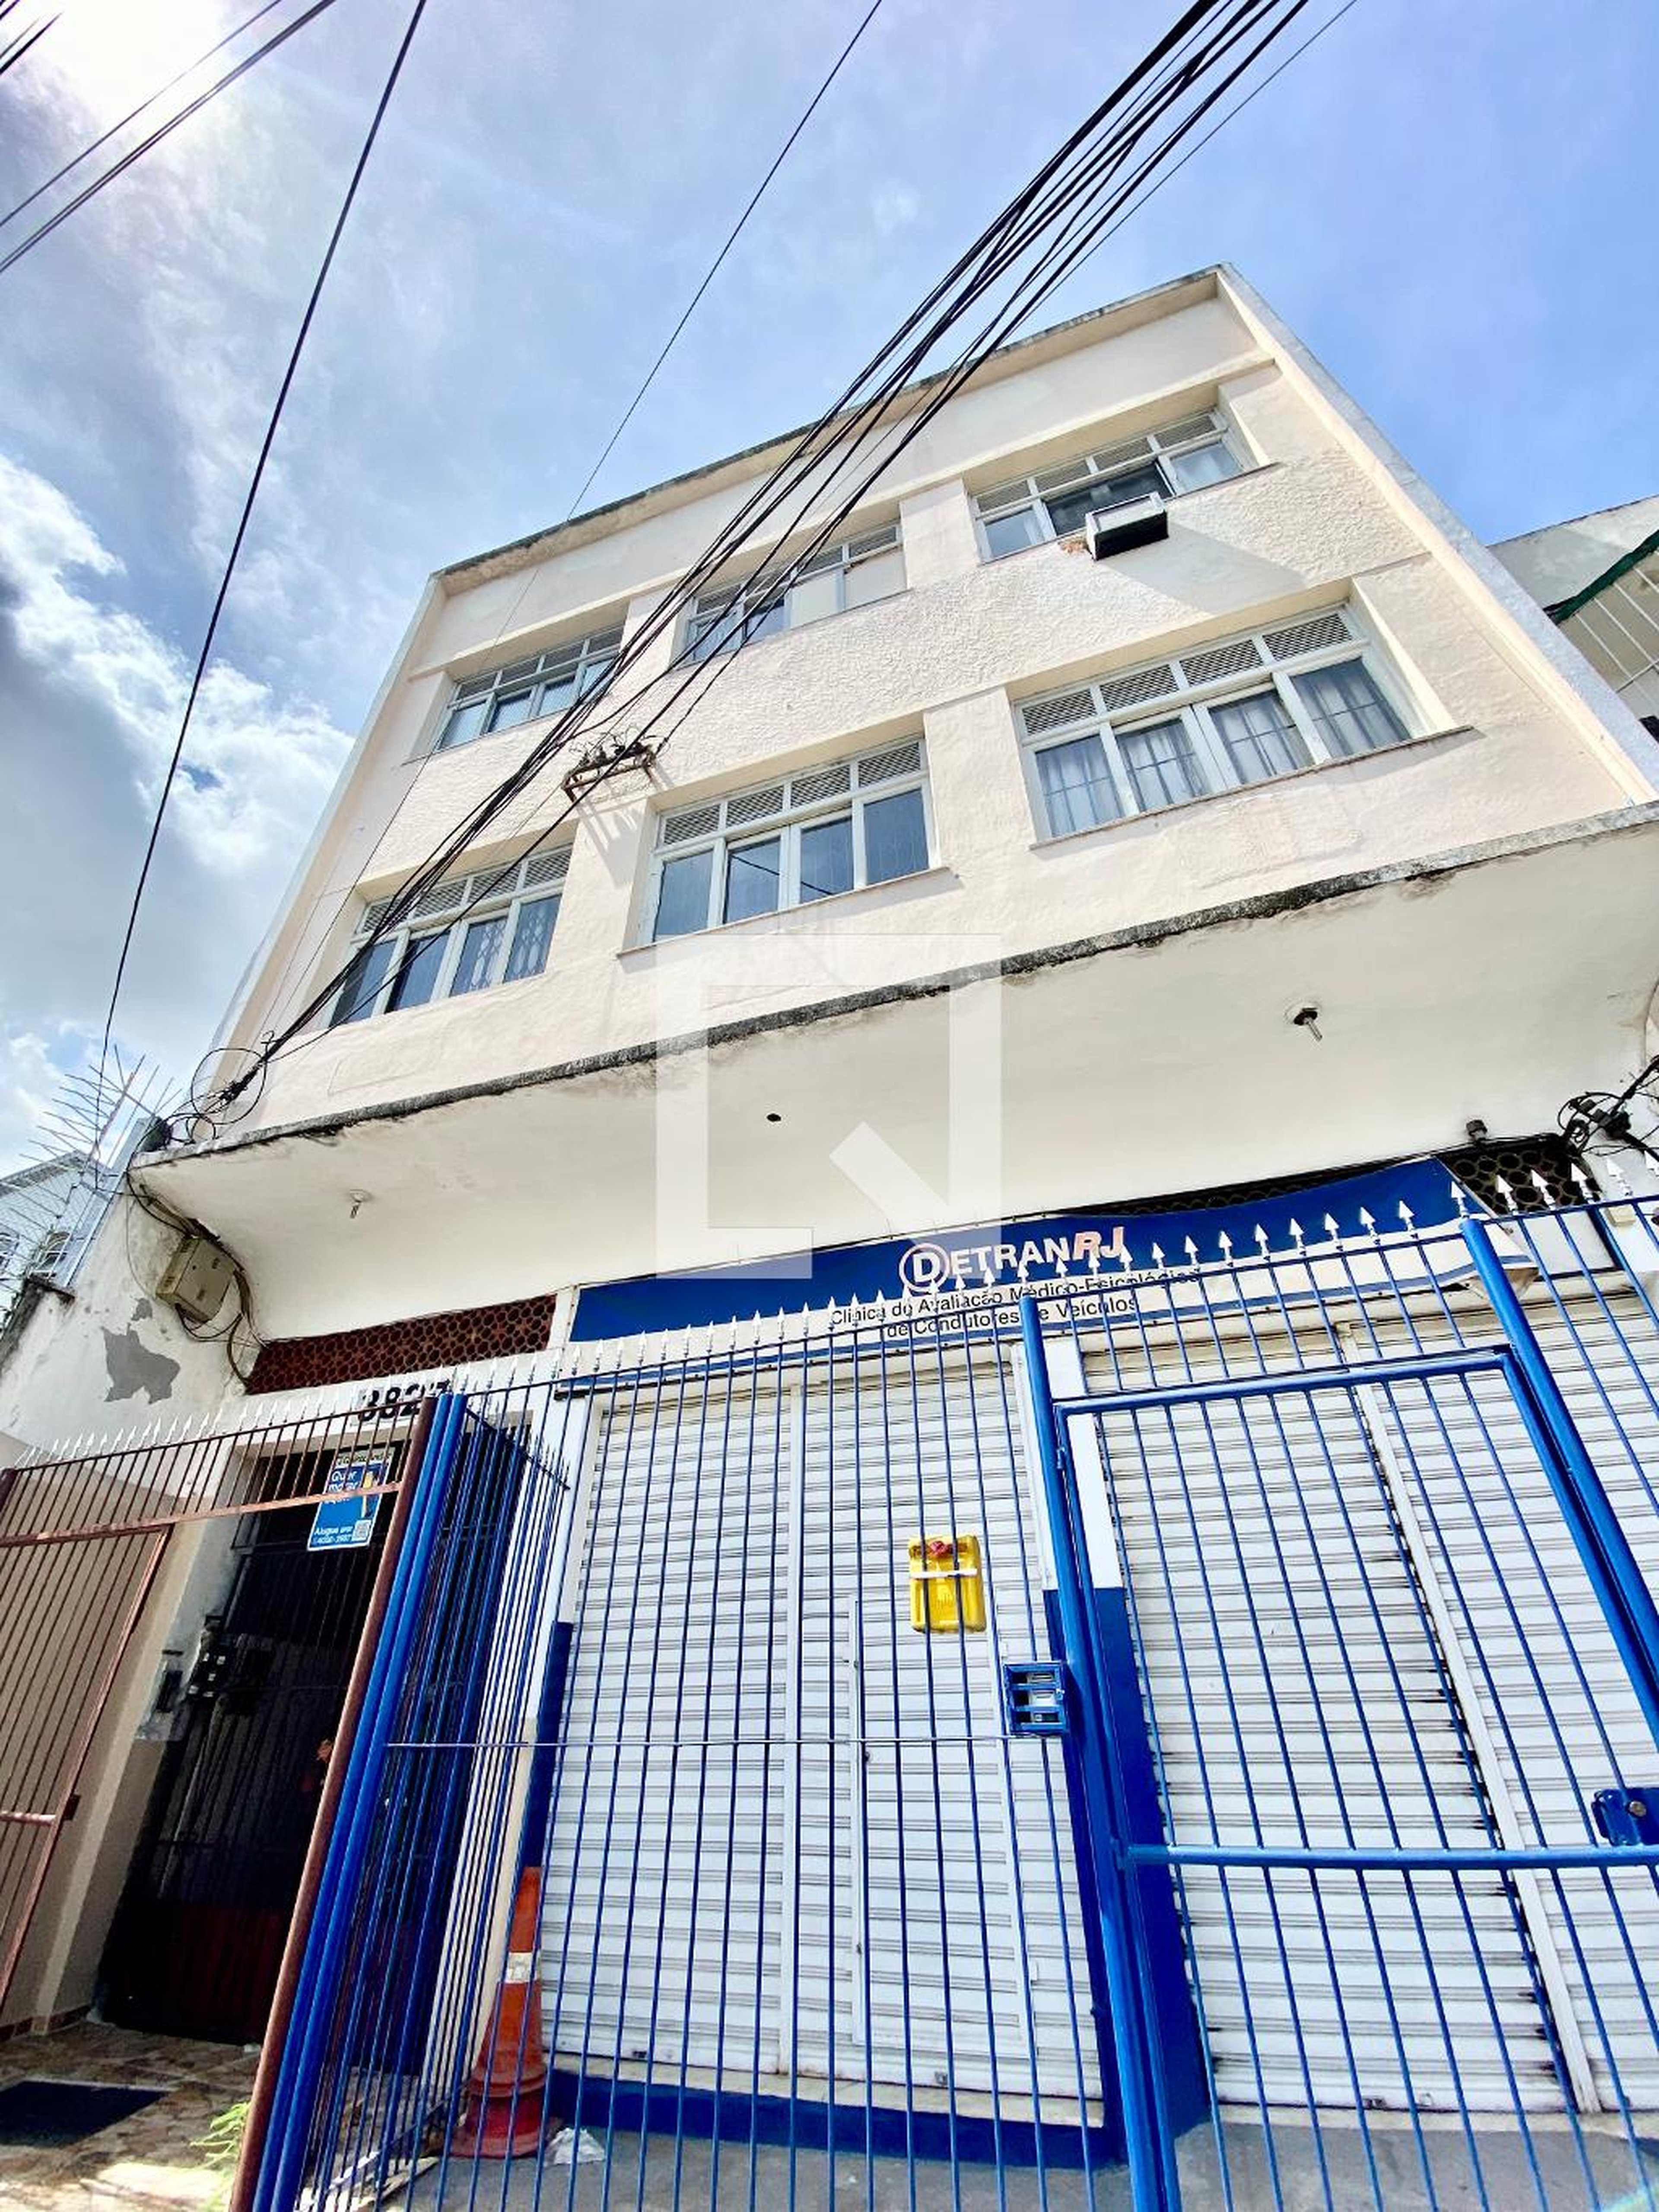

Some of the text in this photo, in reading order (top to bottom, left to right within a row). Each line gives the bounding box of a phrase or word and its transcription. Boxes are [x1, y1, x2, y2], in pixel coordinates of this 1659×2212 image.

[888, 1323, 908, 1337] de
[915, 1311, 1019, 1334] Condutoes
[1056, 1298, 1135, 1318] Veículos
